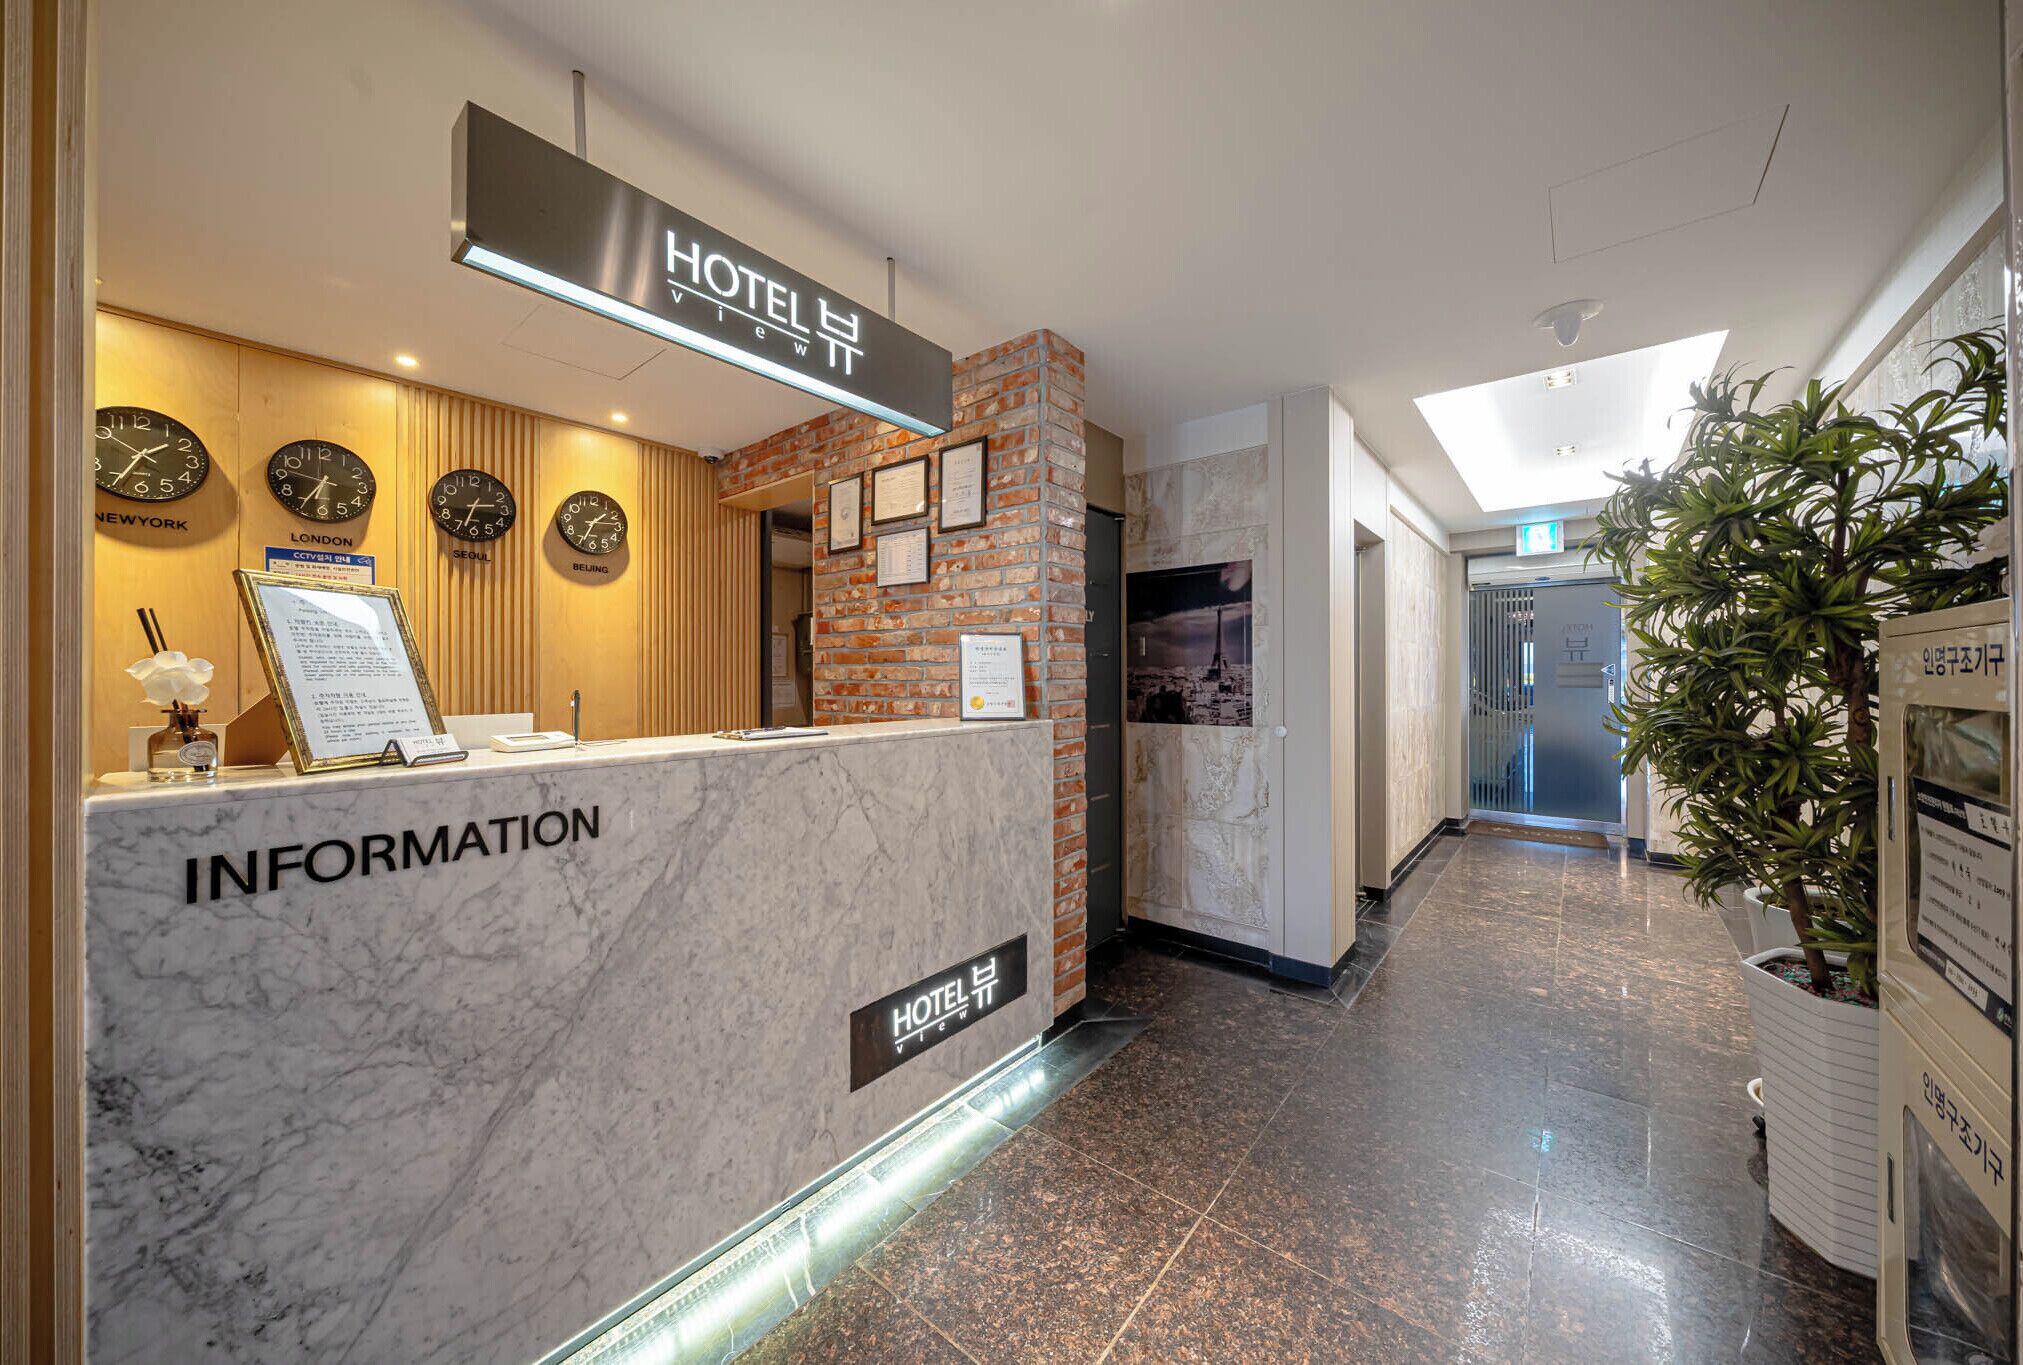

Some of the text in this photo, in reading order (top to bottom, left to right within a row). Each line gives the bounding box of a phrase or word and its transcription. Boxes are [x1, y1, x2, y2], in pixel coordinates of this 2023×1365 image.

[667, 230, 864, 375] HOTEL 뷰
[671, 289, 807, 357] view
[111, 415, 123, 430] 11
[133, 415, 151, 431] 12
[178, 439, 192, 452] 2
[301, 447, 311, 460] 11
[318, 447, 331, 461] 12
[186, 456, 199, 469] 3
[284, 455, 301, 469] 10
[178, 471, 191, 483] 4
[276, 468, 288, 480] 9
[352, 467, 362, 479] 2
[135, 480, 149, 493] 6
[160, 479, 174, 492] 5
[456, 476, 463, 487] 11
[469, 475, 480, 487] 12
[281, 484, 293, 496] 8
[357, 482, 368, 494] 3
[444, 483, 457, 495] 10
[351, 496, 361, 507] 4
[438, 496, 446, 505] 9
[496, 492, 504, 502] 2
[580, 496, 586, 506] 11
[590, 496, 599, 506] 12
[317, 505, 328, 516] 6
[337, 503, 348, 515] 5
[442, 509, 451, 519] 8
[500, 505, 509, 516] 3
[569, 503, 580, 513] 10
[564, 514, 571, 523] 9
[611, 511, 619, 520] 2
[455, 520, 462, 530] 7
[496, 518, 504, 527] 4
[614, 522, 621, 531] 3
[470, 526, 478, 535] 6
[485, 524, 494, 534] 5
[567, 525, 575, 535] 8
[291, 533, 353, 547] LONDON
[577, 535, 583, 544] 7
[610, 533, 616, 541] 4
[589, 540, 596, 549] 6
[601, 539, 608, 548] 5
[293, 552, 351, 564] CCTV설치 안내
[453, 550, 491, 562] SEOUL
[573, 562, 608, 574] BEIJING
[1923, 643, 2005, 677] 인명구조기구
[186, 805, 599, 904] INFORMATION
[893, 957, 999, 1037] HOTEL 뷰
[896, 1009, 967, 1054] view
[1922, 1071, 2005, 1187] 인명구조기구
